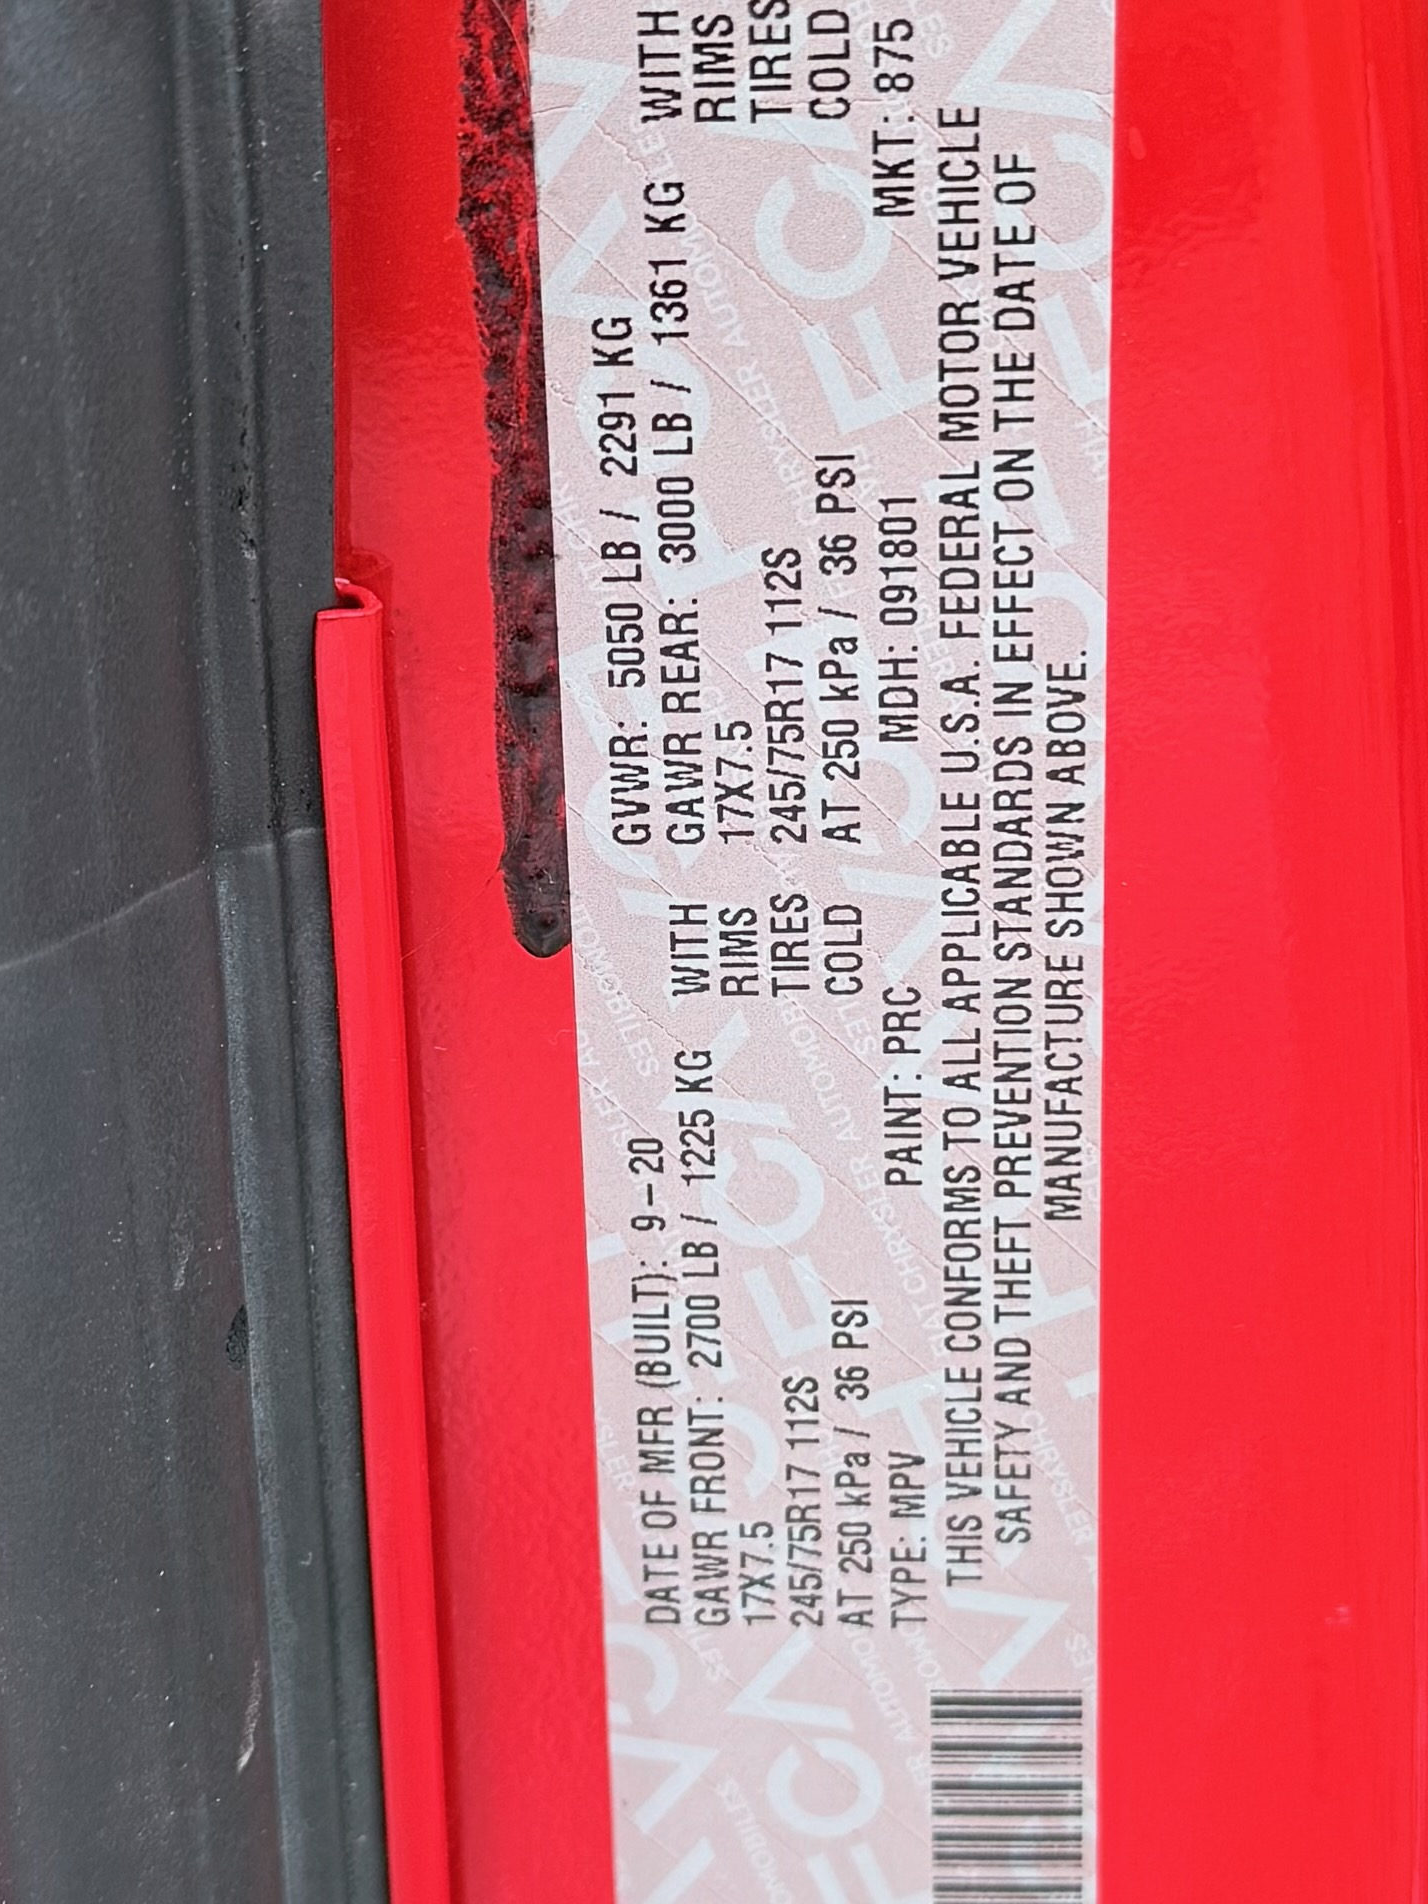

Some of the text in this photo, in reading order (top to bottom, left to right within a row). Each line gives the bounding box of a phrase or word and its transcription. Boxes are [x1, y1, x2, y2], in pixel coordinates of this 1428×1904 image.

[637, 11, 682, 123] WITH
[692, 15, 736, 122] RIMS
[808, 9, 851, 119] COLD
[872, 19, 914, 217] MKT: 875
[644, 182, 686, 233] KG
[591, 317, 633, 366] KG
[648, 260, 689, 345] 1361
[597, 392, 637, 477] 2291
[652, 413, 693, 455] LB
[656, 477, 696, 563] 3000
[815, 455, 856, 513] PSI
[601, 542, 642, 582] LB
[819, 534, 857, 575] 36
[605, 603, 645, 687] 5050
[659, 599, 701, 713] REAR:
[878, 498, 918, 742] MDH: 091801
[761, 548, 807, 844] 245/75R17 112S
[819, 637, 859, 701] kPa
[609, 722, 651, 845] GVWR:
[663, 731, 705, 844] GAWR
[714, 721, 755, 844] 17X7.5
[822, 719, 860, 781] 250
[821, 799, 861, 844] AT
[938, 107, 983, 1587] THIS VEHICLE CONFORMS TO ALL APPLICABLE U.S.A. FEDERAL MOTOR VEHICLE
[993, 154, 1036, 1543] SAFETY AND THEFT PREVENTION STANDARDS IN EFFECT ON THE DATE OF
[669, 904, 710, 996] WITH
[718, 908, 759, 996] RIMS
[770, 894, 810, 997] TIRES
[823, 905, 863, 995] COLD
[1044, 651, 1086, 1220] MANUFACTURE SHOWN ABOVE.
[674, 1051, 713, 1092] KG
[883, 987, 922, 1185] PAINT: PRC
[678, 1109, 715, 1186] 1225
[682, 1242, 719, 1277] LB
[631, 1261, 680, 1388] (BUILT):
[685, 1295, 722, 1368] 2700
[831, 1300, 869, 1349] PSI
[834, 1366, 869, 1401] 36
[637, 1406, 675, 1473] MFR
[687, 1397, 726, 1513] FRONT:
[835, 1452, 871, 1506] kPa
[640, 1490, 677, 1529] OF
[782, 1377, 824, 1627] 245/75R17 112S
[888, 1451, 927, 1628] TYPE: MPV
[642, 1544, 681, 1624] DATE
[692, 1531, 730, 1626] GAWR
[738, 1522, 776, 1626] 17X7.5
[837, 1522, 873, 1574] 250
[837, 1589, 873, 1628] AT
